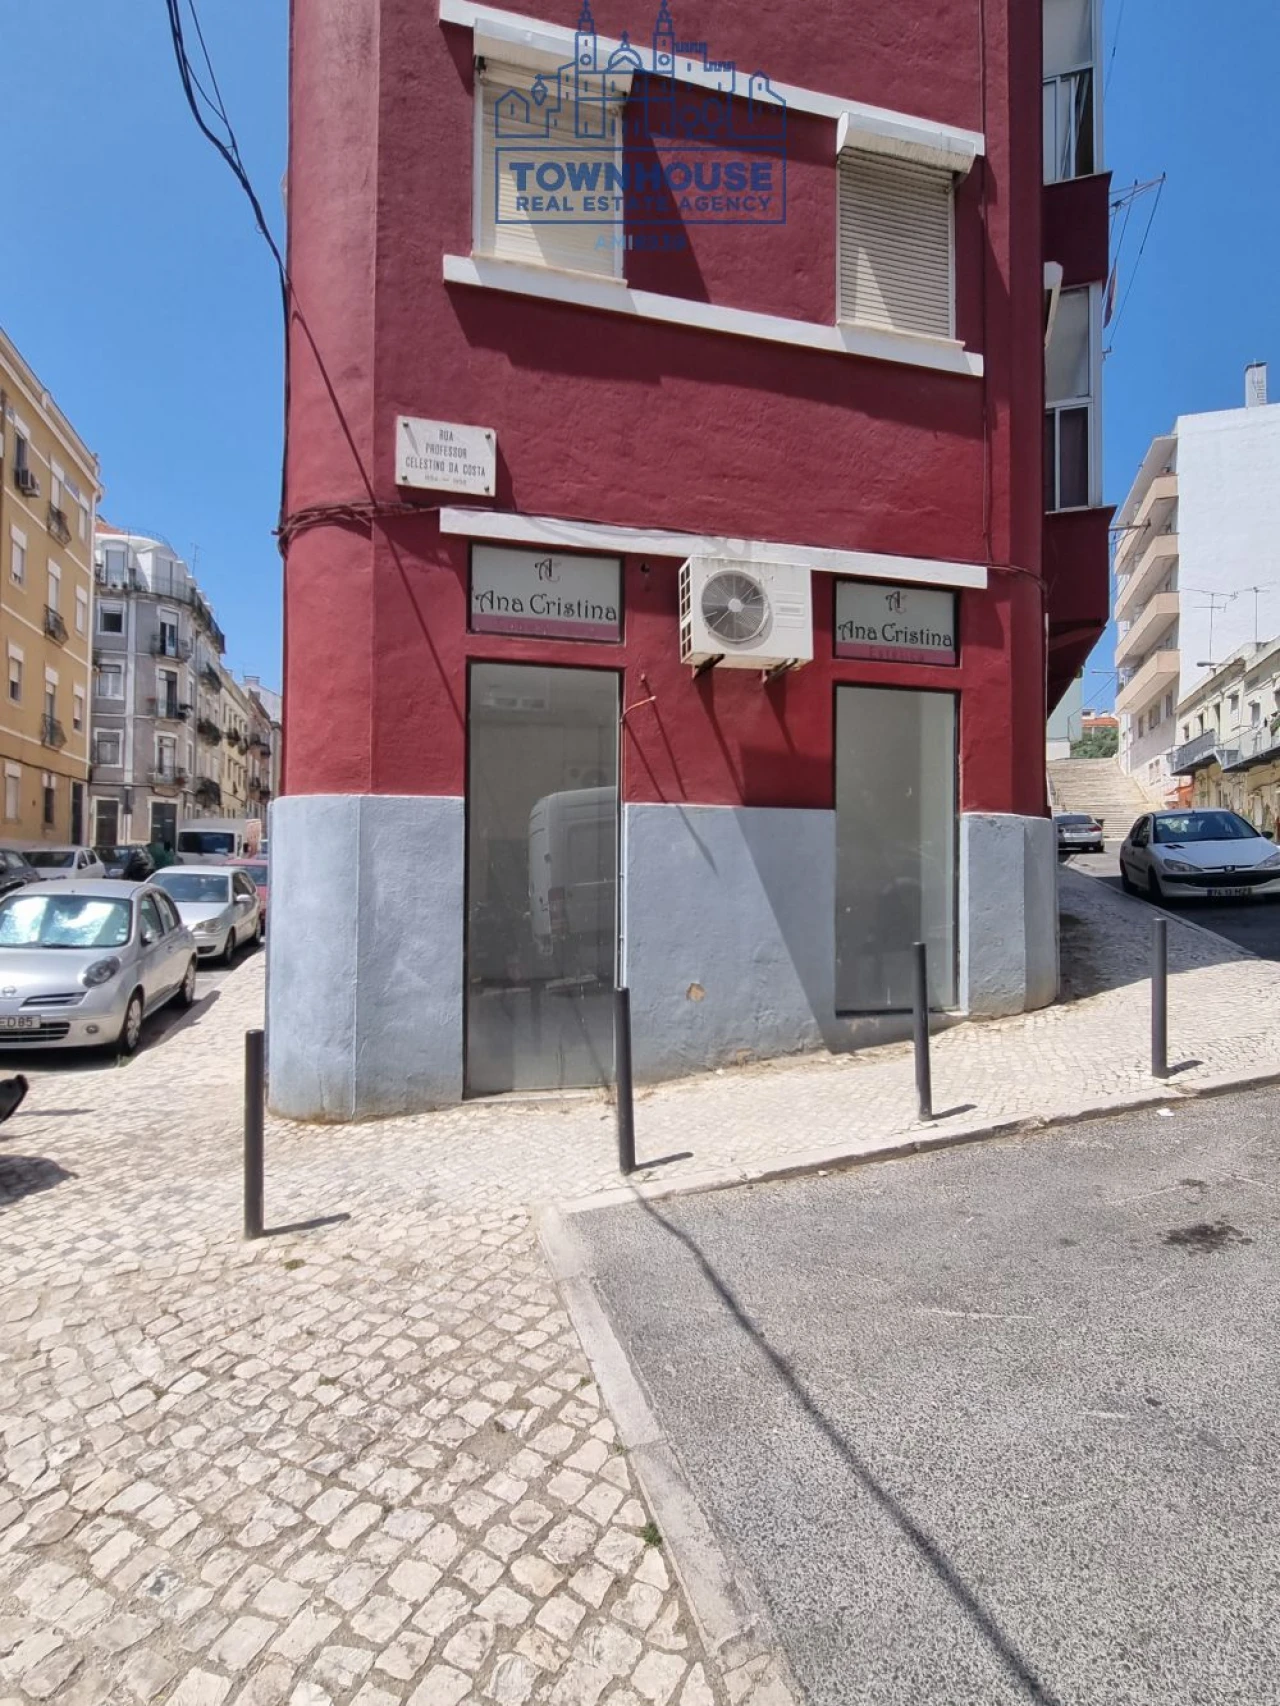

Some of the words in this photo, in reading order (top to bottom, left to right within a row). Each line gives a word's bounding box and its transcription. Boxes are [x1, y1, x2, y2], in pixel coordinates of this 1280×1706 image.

[439, 429, 454, 441] RUA
[425, 442, 467, 459] PROFESSOR
[405, 456, 445, 472] CELESTINO
[448, 462, 459, 474] DA
[463, 464, 486, 477] COSTA
[475, 590, 524, 613] Ana
[529, 593, 618, 621] Cristina
[838, 620, 878, 641] Ana
[881, 622, 953, 647] Cristina
